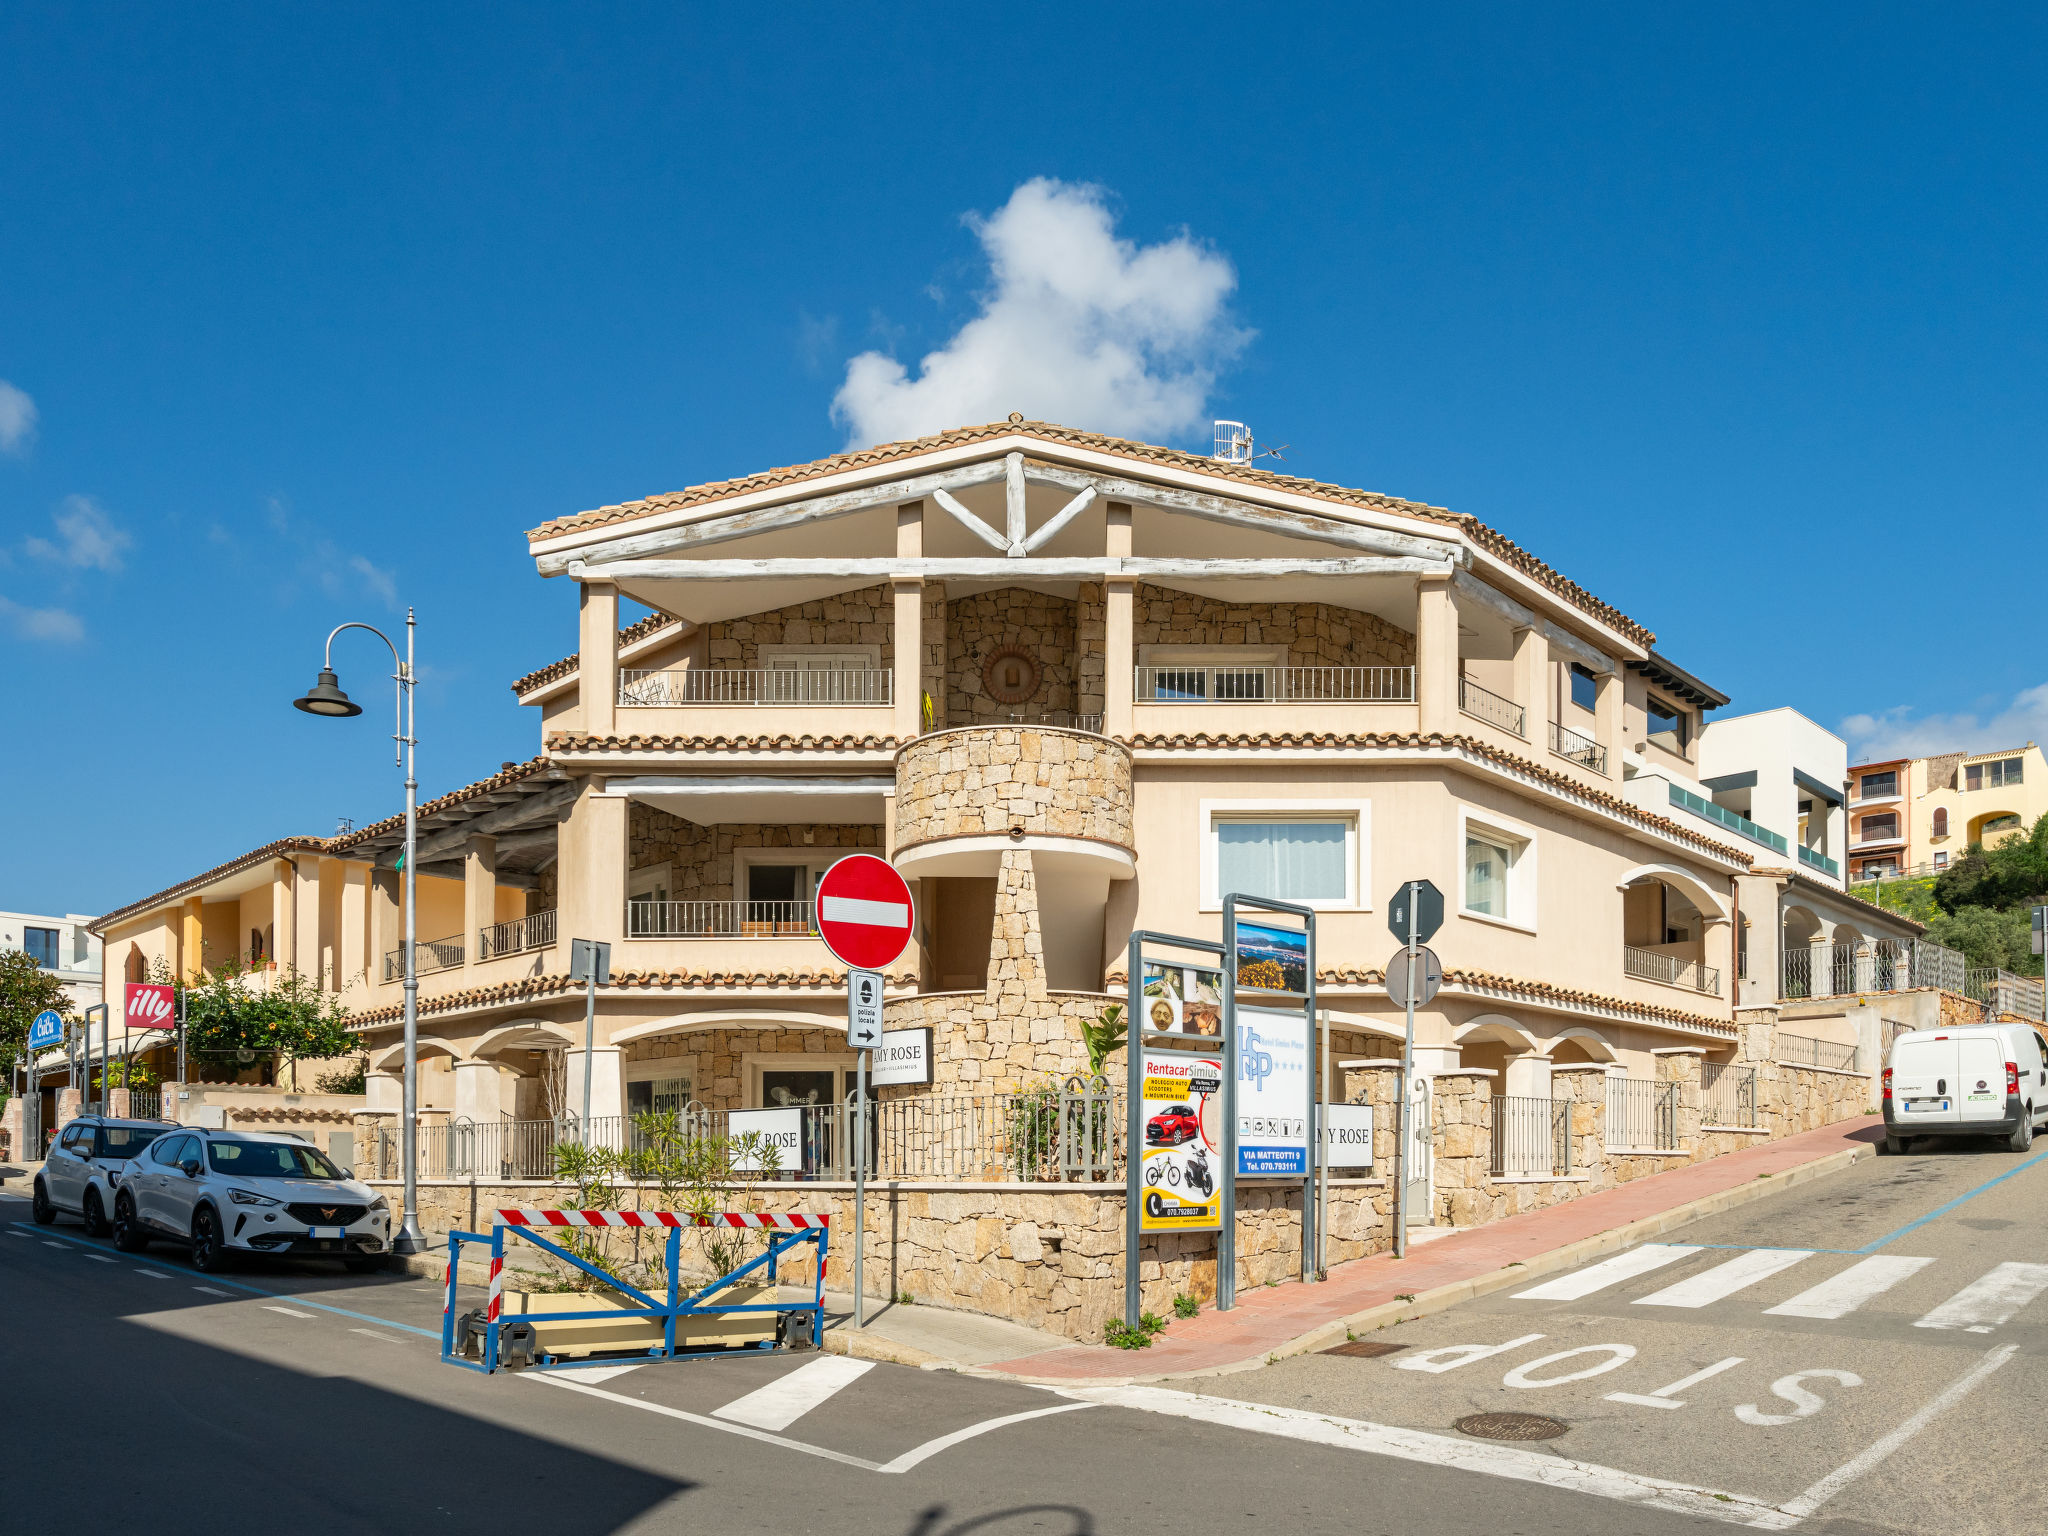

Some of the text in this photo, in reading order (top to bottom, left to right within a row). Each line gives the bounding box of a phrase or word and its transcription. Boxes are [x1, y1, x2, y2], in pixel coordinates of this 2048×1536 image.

[128, 989, 172, 1024] illy
[890, 1045, 922, 1061] ROSE
[1147, 1062, 1218, 1078] RentacarSimius
[764, 1132, 798, 1148] ROSE
[1339, 1128, 1369, 1144] ROSE
[1243, 1151, 1301, 1160] VIA MATTEOTTI 9
[1246, 1162, 1297, 1171] Tel. 070.793111
[1391, 1333, 1864, 1426] STOP
